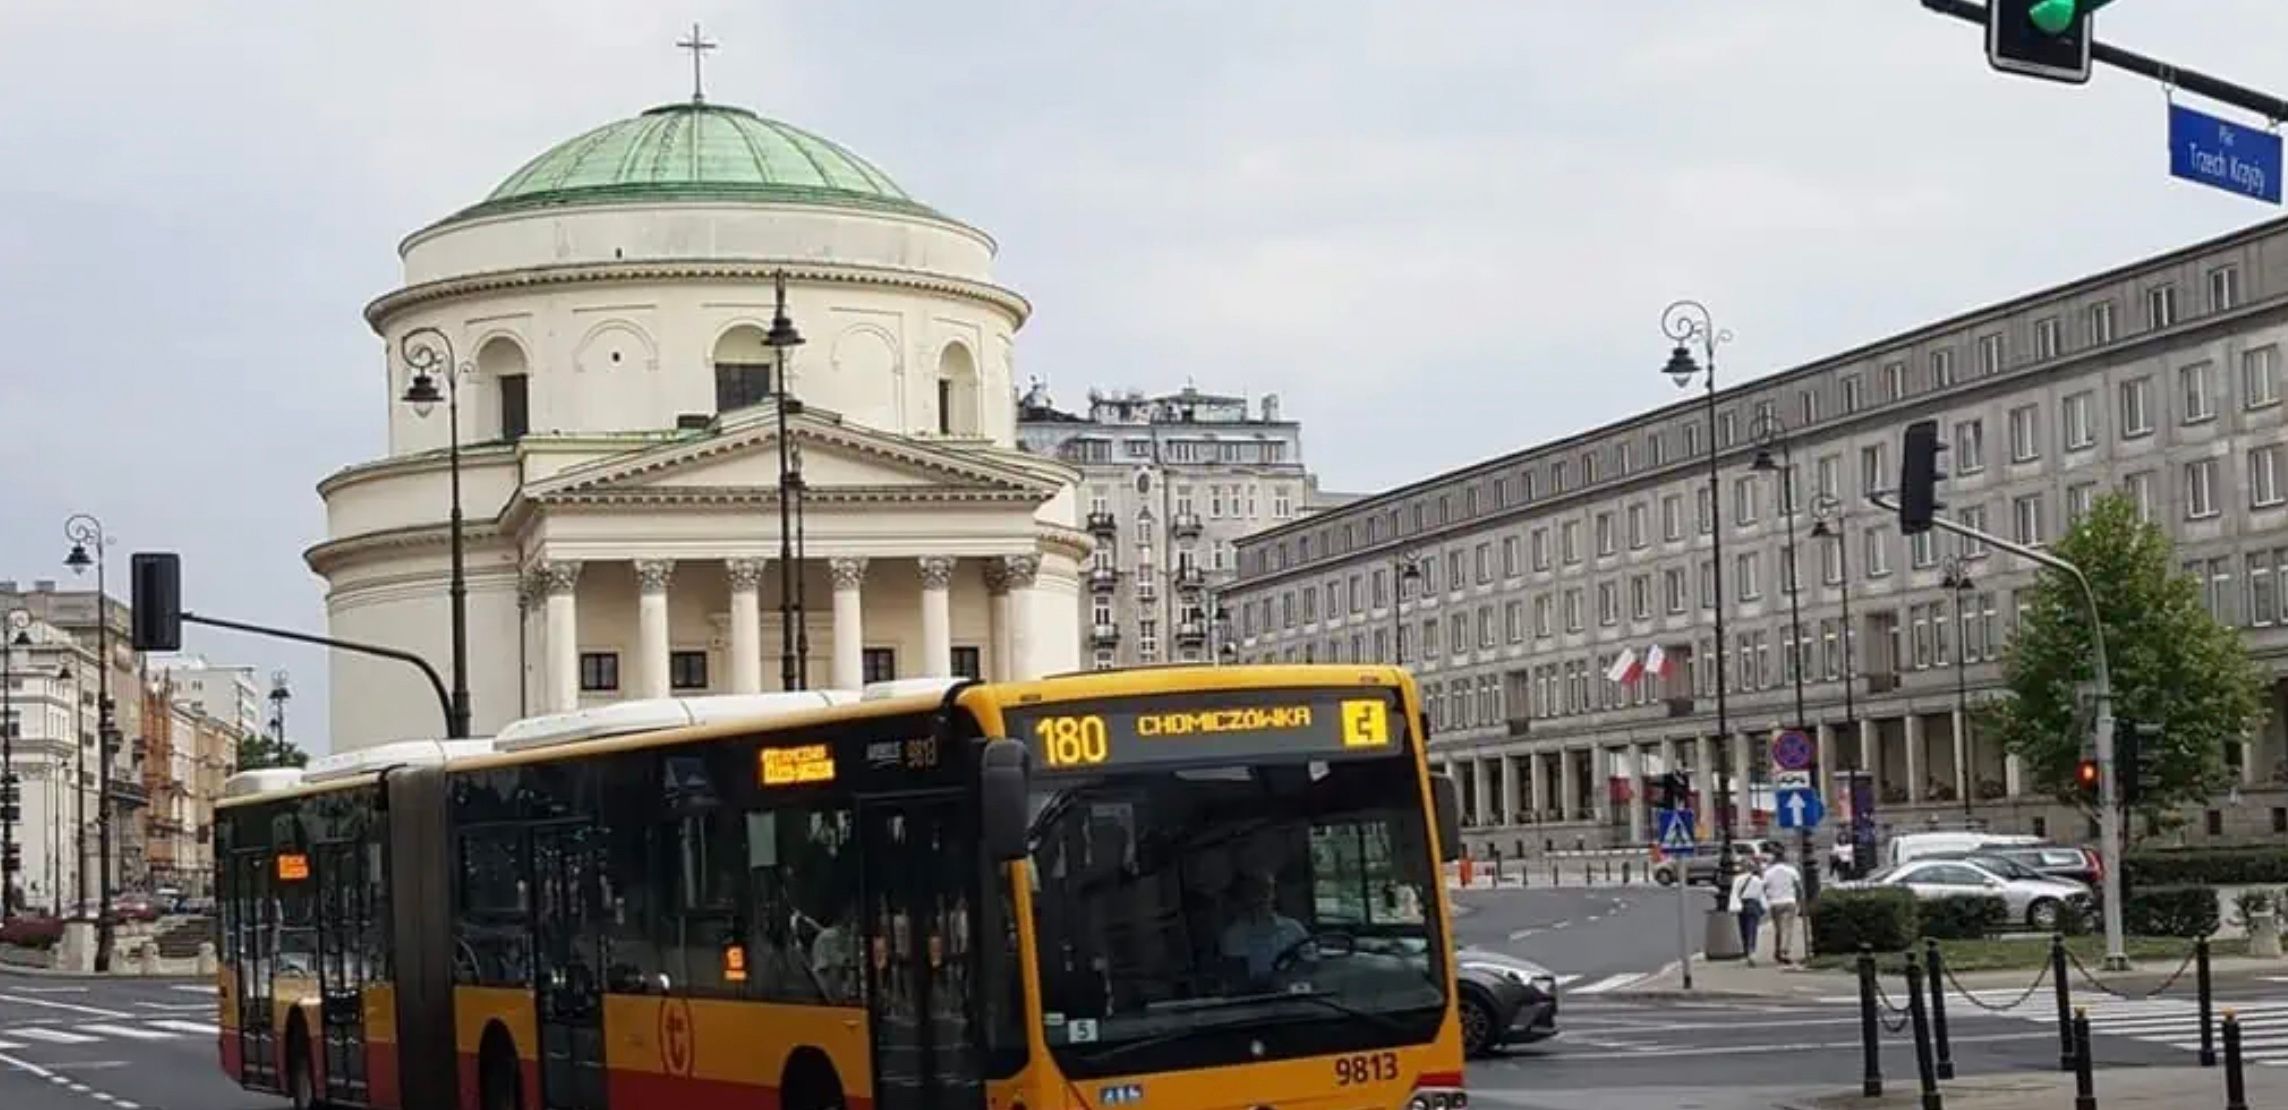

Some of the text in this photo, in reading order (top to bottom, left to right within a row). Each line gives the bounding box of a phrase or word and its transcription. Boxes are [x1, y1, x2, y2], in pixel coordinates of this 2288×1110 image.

[1035, 706, 1312, 765] 180 CHOMICZÓWKA
[1077, 1022, 1090, 1039] 5
[1335, 1052, 1399, 1085] 9813
